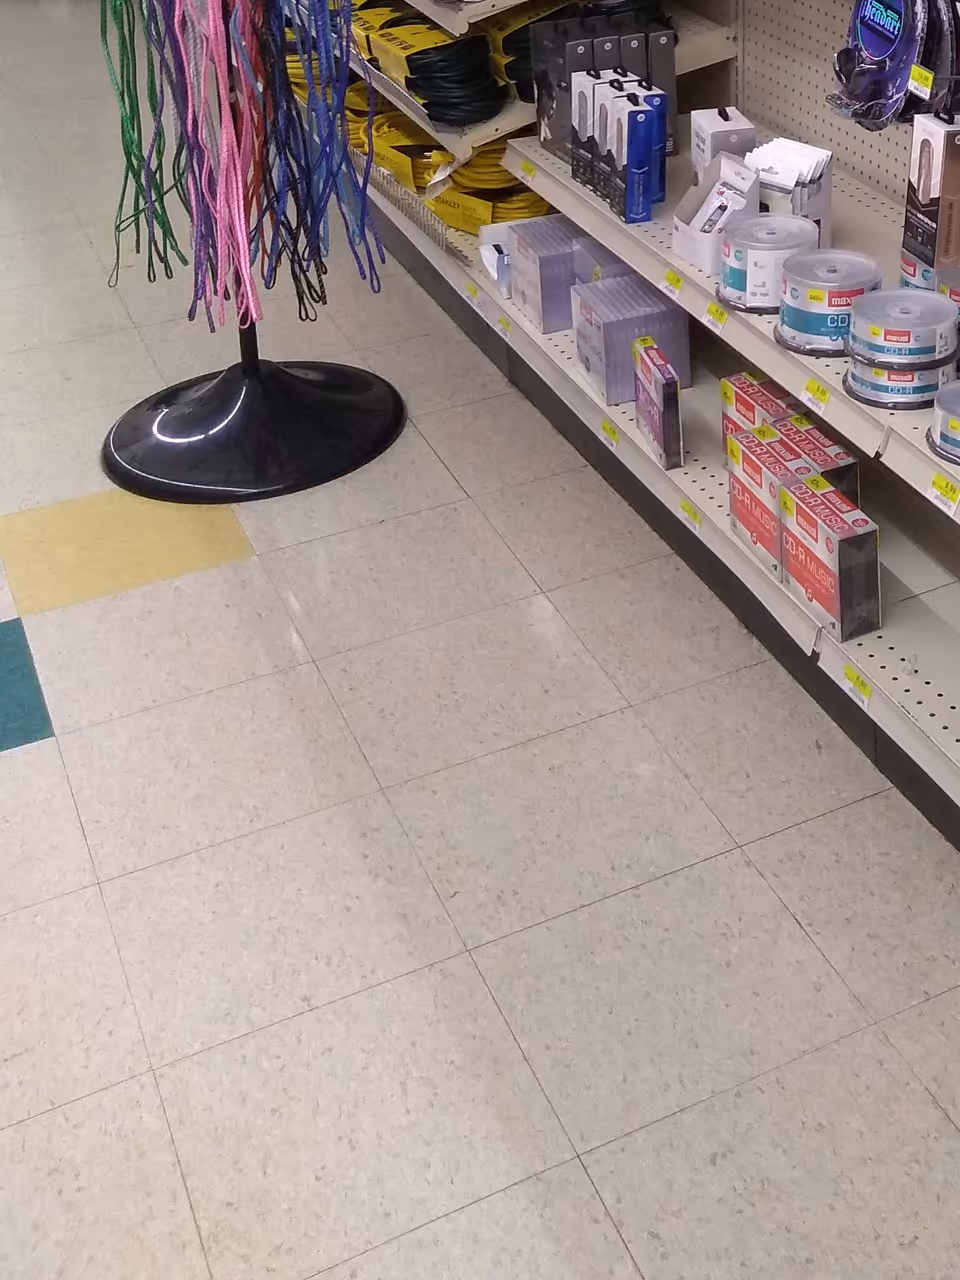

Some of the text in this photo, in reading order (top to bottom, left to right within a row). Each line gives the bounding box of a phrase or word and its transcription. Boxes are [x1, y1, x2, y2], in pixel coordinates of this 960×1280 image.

[884, 346, 910, 356] CD-R
[885, 334, 910, 343] maxell
[731, 375, 785, 416] CD-R MUSIC
[888, 385, 914, 395] CD-R
[889, 373, 914, 382] maxell
[737, 433, 793, 480] CD-R MUSIC
[776, 420, 831, 465] CD-R MUSIC
[731, 478, 779, 537] CD-R MUSIC
[790, 482, 849, 532] CD-R MUSIC
[944, 481, 958, 495] 8.99
[782, 530, 835, 594] CD-R MUSIC
